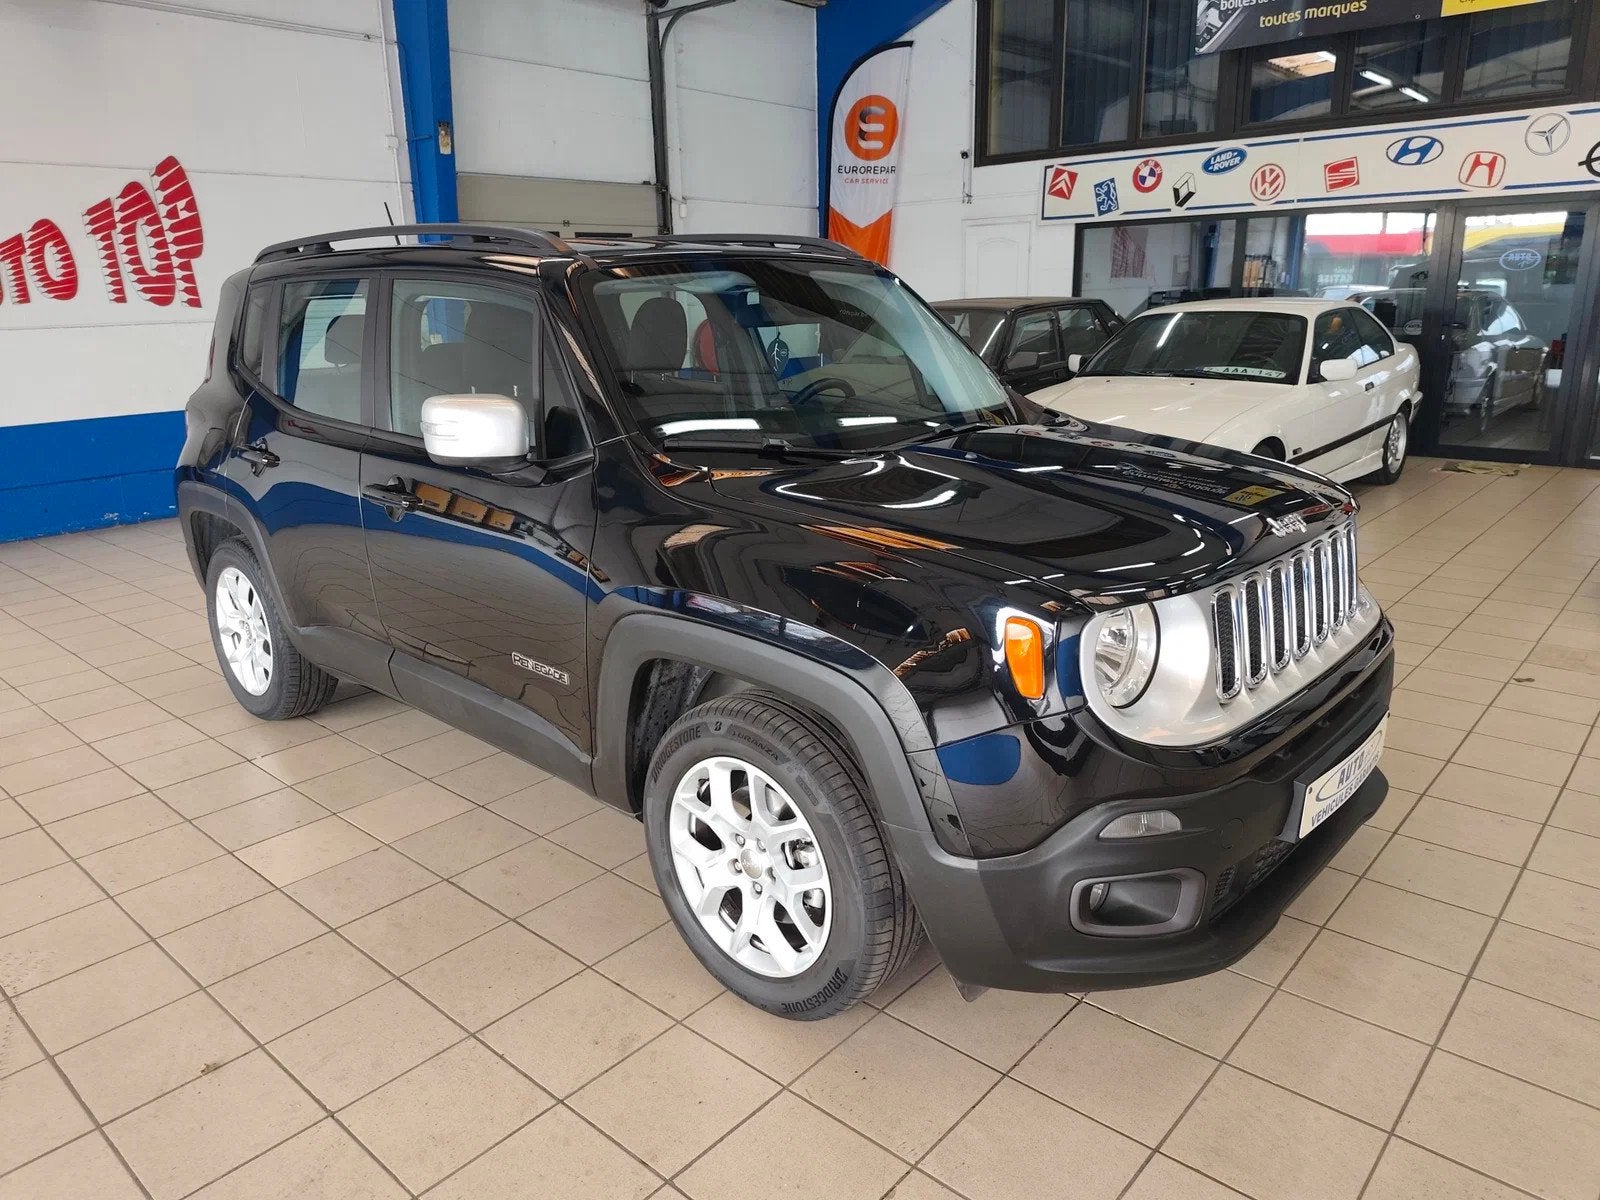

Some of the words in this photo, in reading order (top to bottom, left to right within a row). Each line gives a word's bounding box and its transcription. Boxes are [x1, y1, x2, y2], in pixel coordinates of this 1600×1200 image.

[1259, 9, 1301, 28] toutes
[1304, 0, 1368, 20] marques
[837, 164, 896, 175] EUROREPAR
[1210, 151, 1232, 164] LAND
[1213, 157, 1241, 172] ROVER
[81, 155, 203, 308] TOP
[512, 651, 569, 685] RENEGADE
[651, 724, 702, 784] BRIDGESTONE
[781, 966, 849, 1014] BRIDGESTONE
